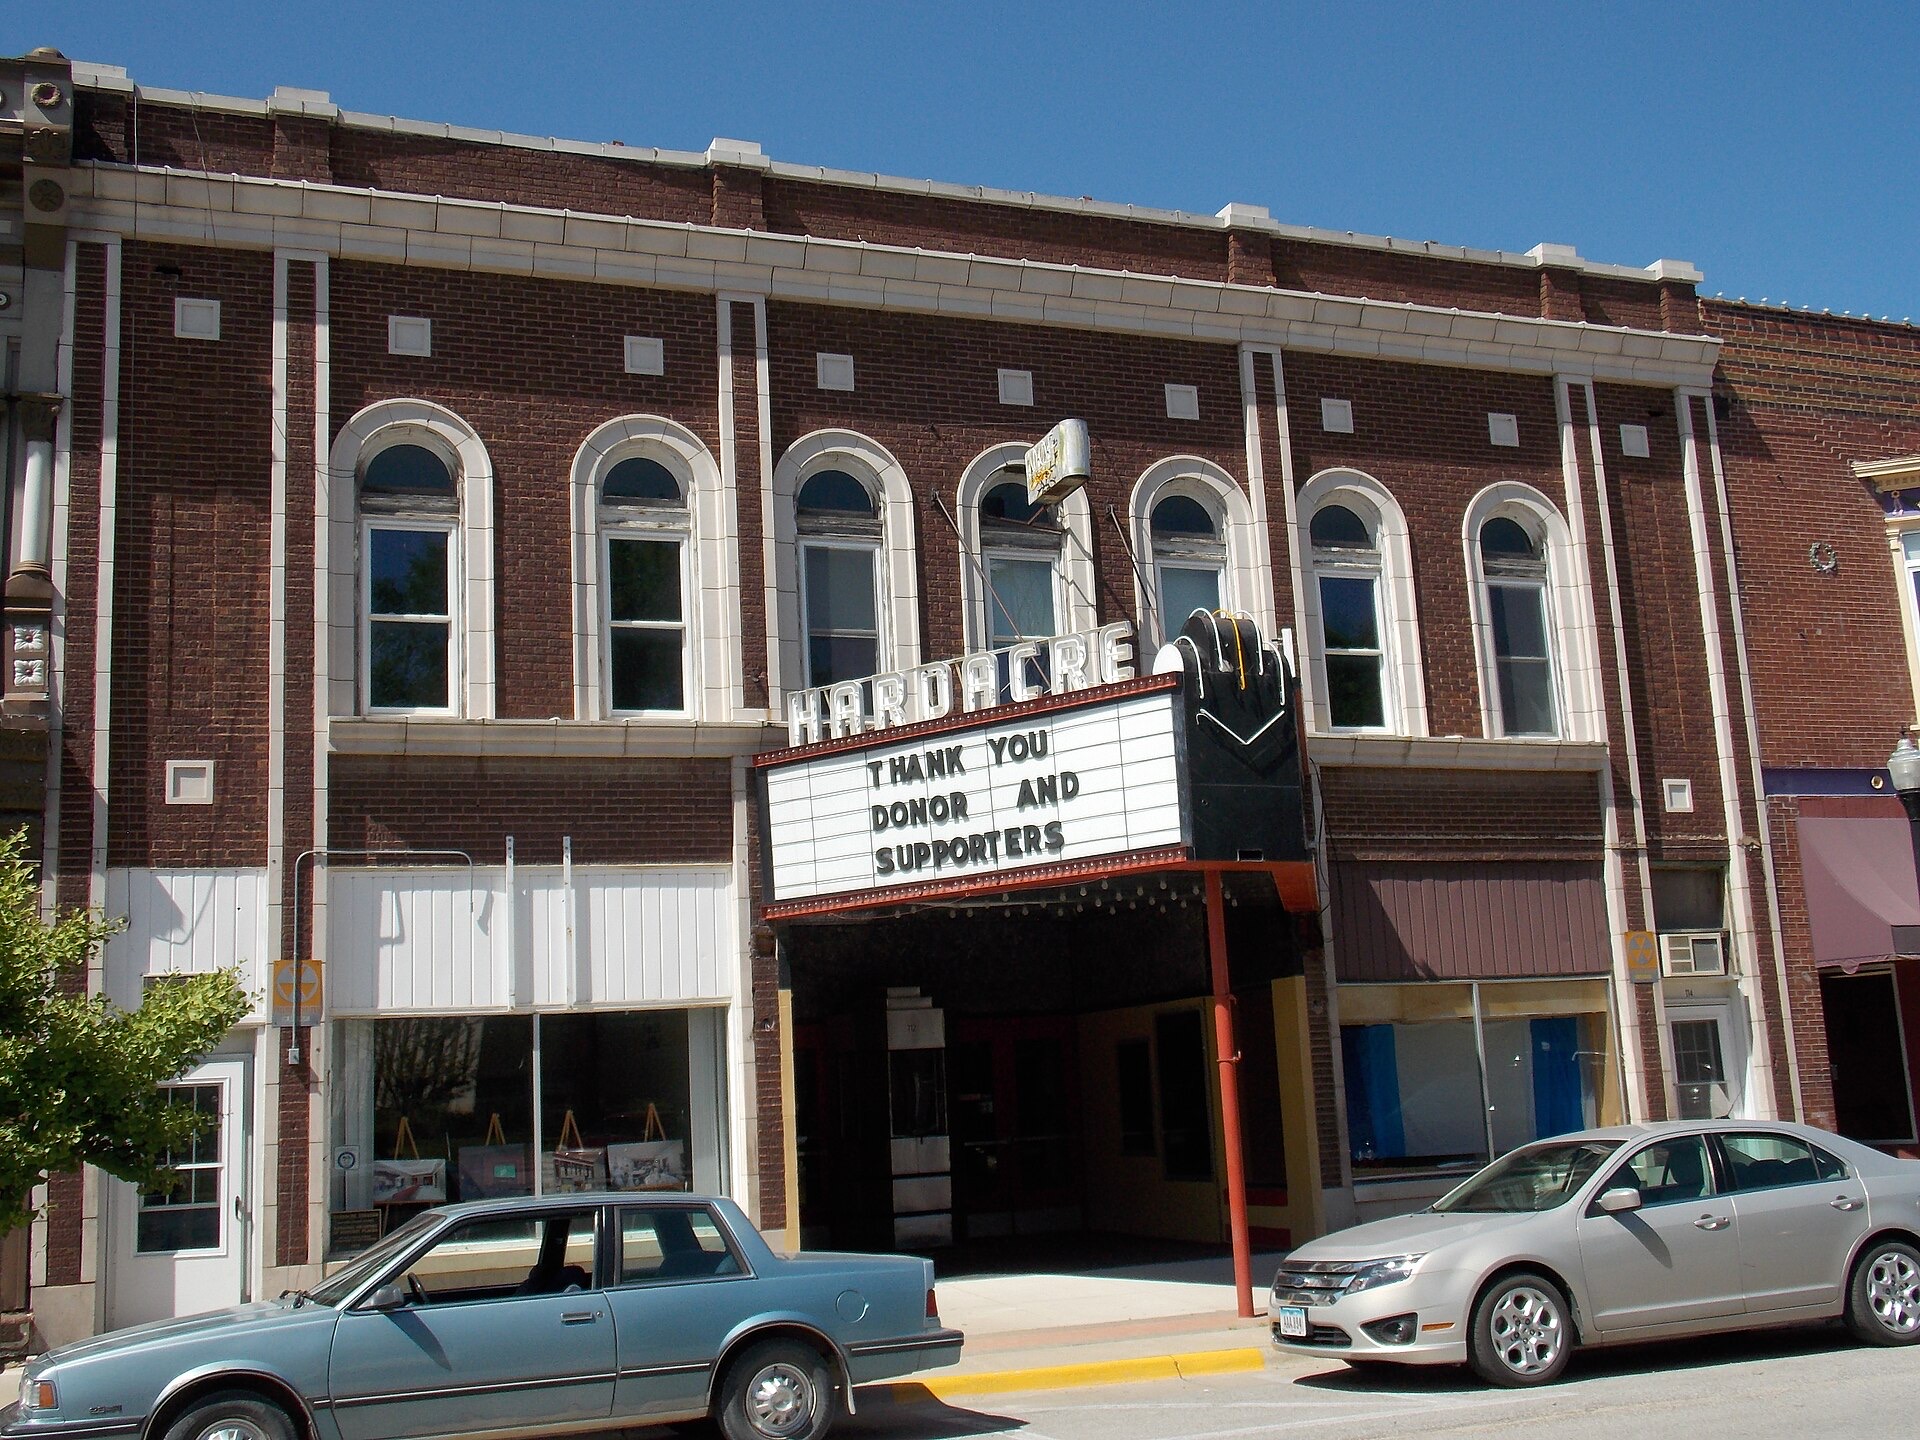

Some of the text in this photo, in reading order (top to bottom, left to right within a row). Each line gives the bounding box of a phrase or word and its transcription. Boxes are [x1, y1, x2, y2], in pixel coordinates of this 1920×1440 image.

[787, 621, 1135, 748] HARDACRE
[867, 730, 1048, 788] THANK YOU
[871, 771, 1080, 831] DONOR AND
[875, 821, 1065, 874] SUPPORTERS
